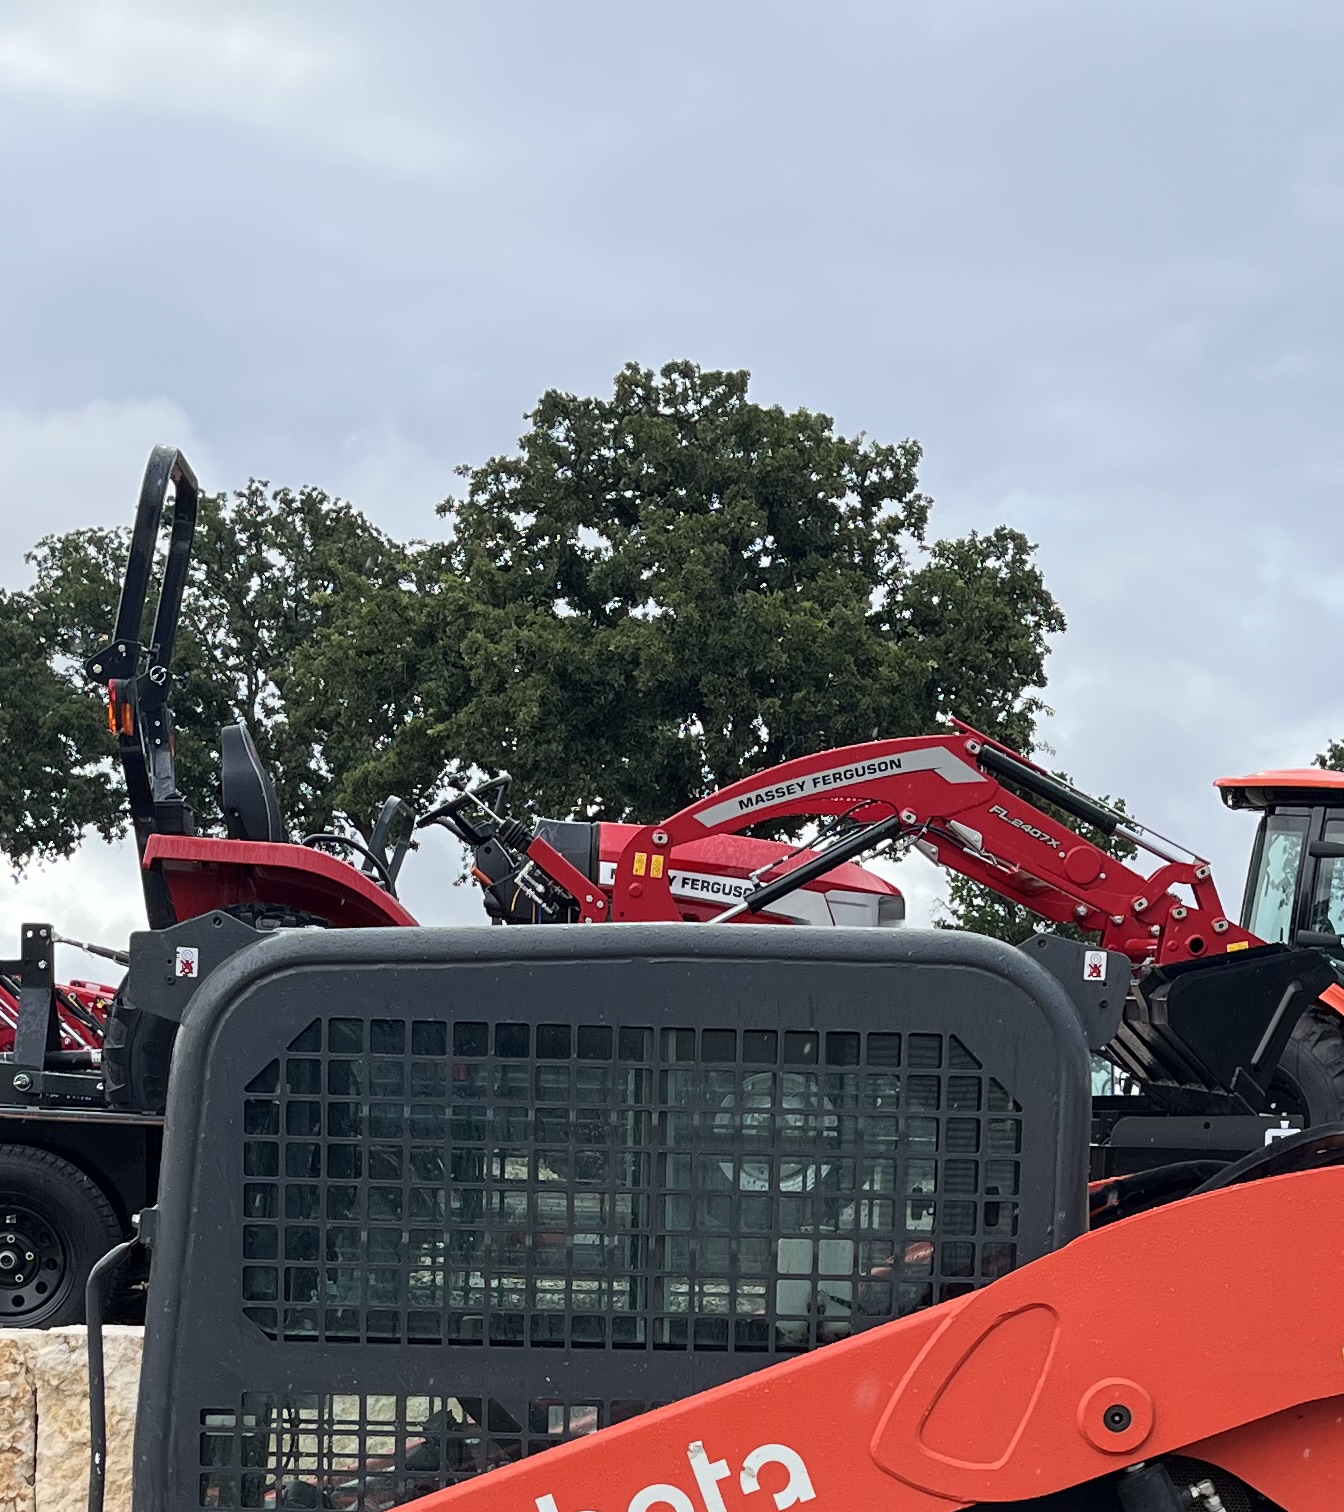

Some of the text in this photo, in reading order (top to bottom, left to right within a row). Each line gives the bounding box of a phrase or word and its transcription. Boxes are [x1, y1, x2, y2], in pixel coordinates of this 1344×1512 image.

[738, 758, 902, 810] MASSEY FERGUSON
[681, 877, 754, 898] FERGUSO
